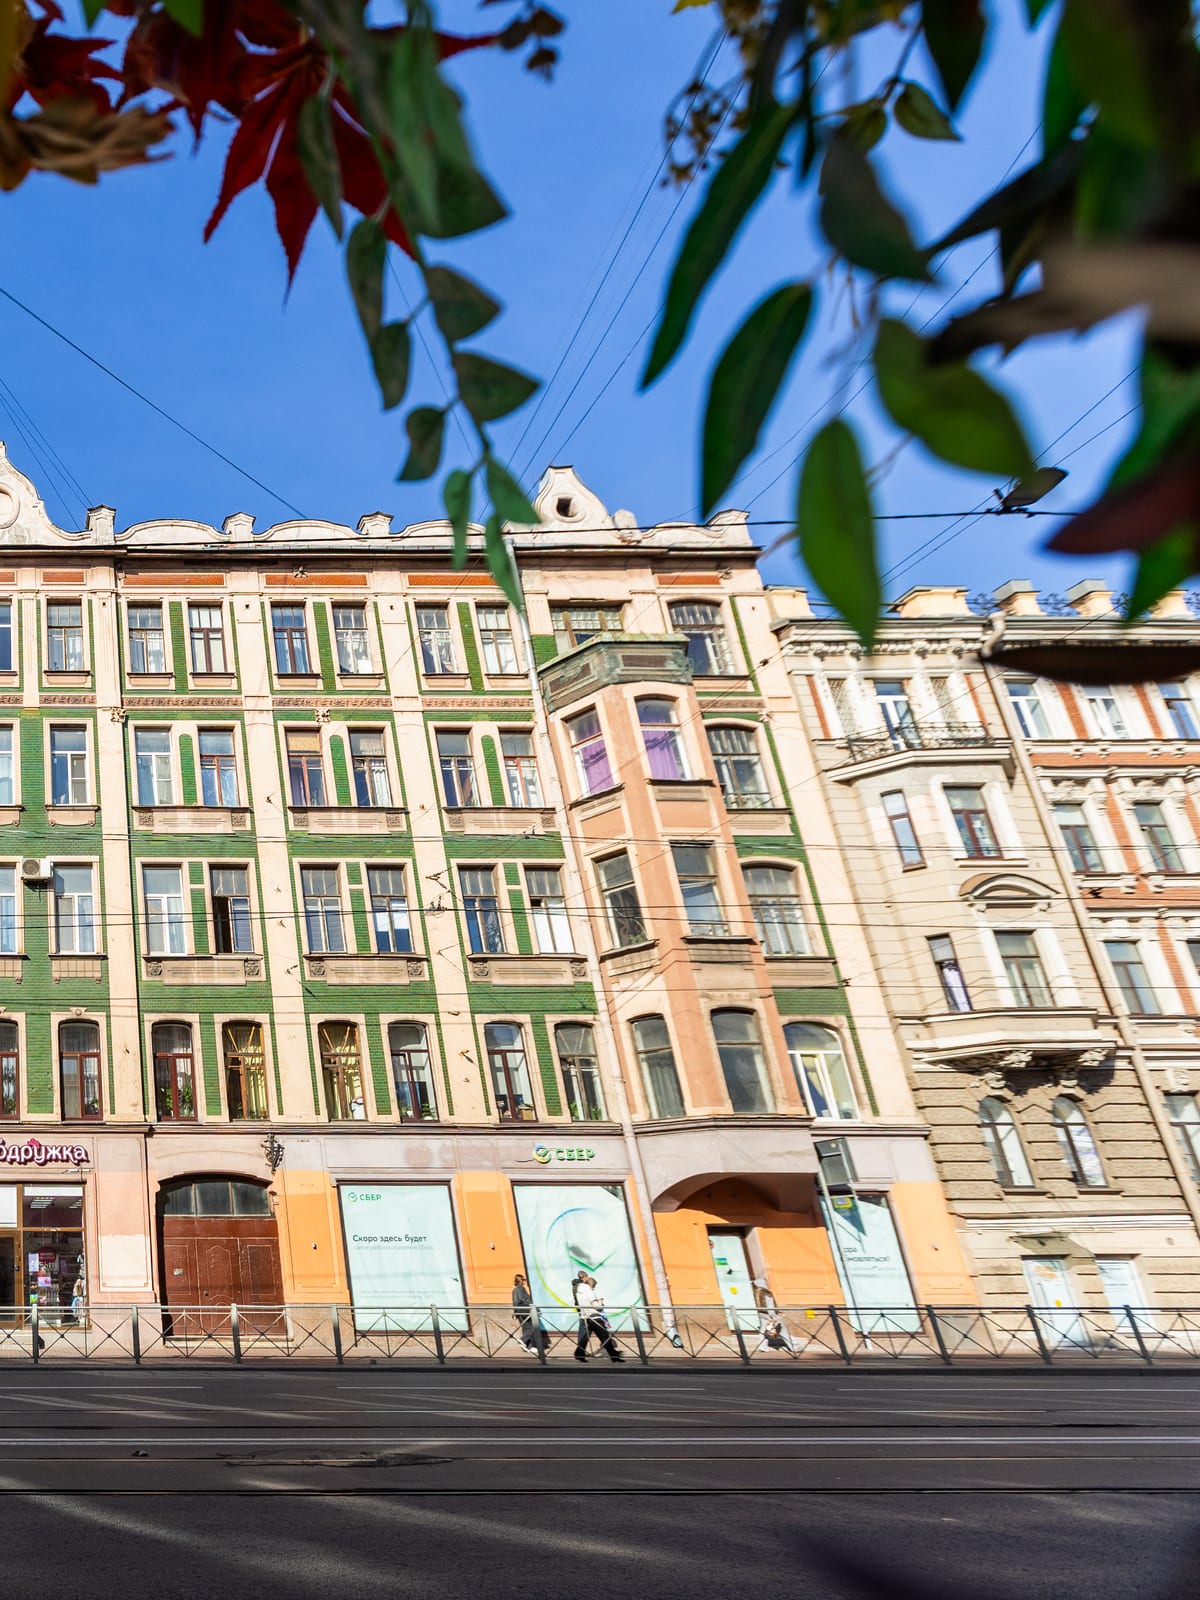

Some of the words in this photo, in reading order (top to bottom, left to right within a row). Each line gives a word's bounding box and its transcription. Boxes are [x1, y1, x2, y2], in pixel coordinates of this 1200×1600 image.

[554, 1147, 596, 1161] СБЕР
[359, 1193, 382, 1201] СБЕР
[352, 1234, 378, 1243] Скоро
[404, 1234, 427, 1243] будет
